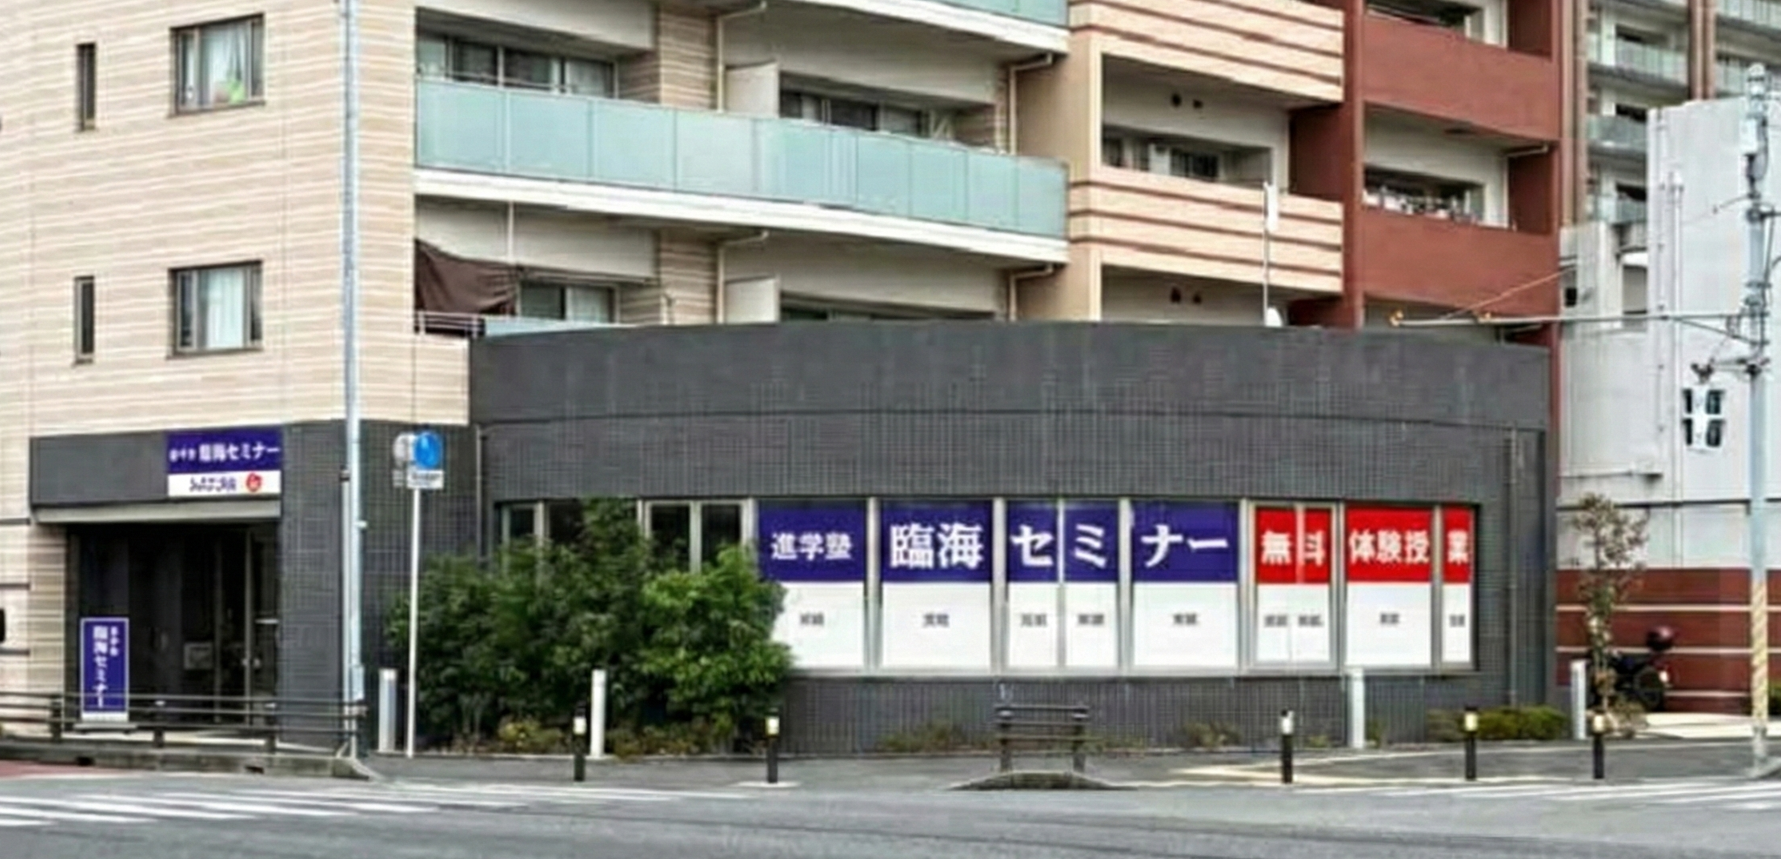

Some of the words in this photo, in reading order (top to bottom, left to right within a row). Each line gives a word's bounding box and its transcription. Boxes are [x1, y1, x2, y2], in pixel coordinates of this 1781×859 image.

[771, 531, 853, 562] 進学塾
[890, 522, 1229, 569] 臨海セミナー
